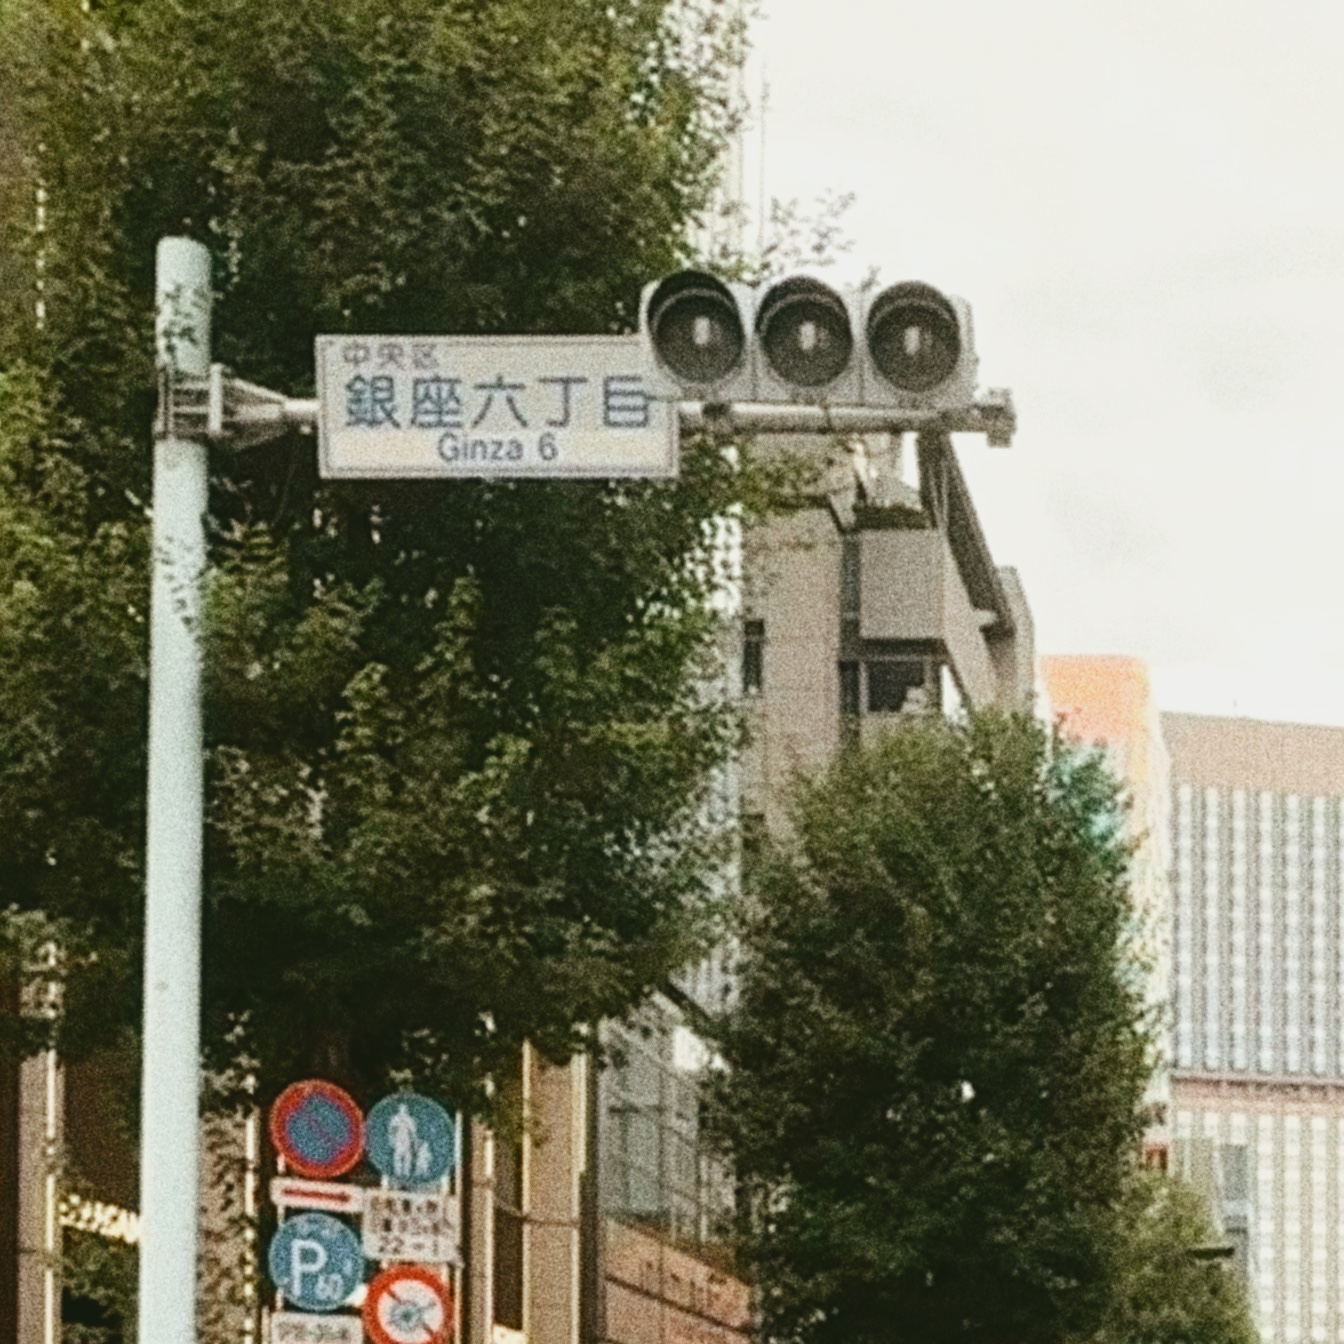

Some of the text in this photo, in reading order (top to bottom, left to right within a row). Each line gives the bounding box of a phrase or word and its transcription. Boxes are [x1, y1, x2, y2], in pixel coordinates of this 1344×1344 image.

[344, 341, 440, 370] 中央区
[345, 375, 649, 428] 銀座六丁目
[438, 431, 558, 462] Ginza 6
[290, 1238, 328, 1297] P
